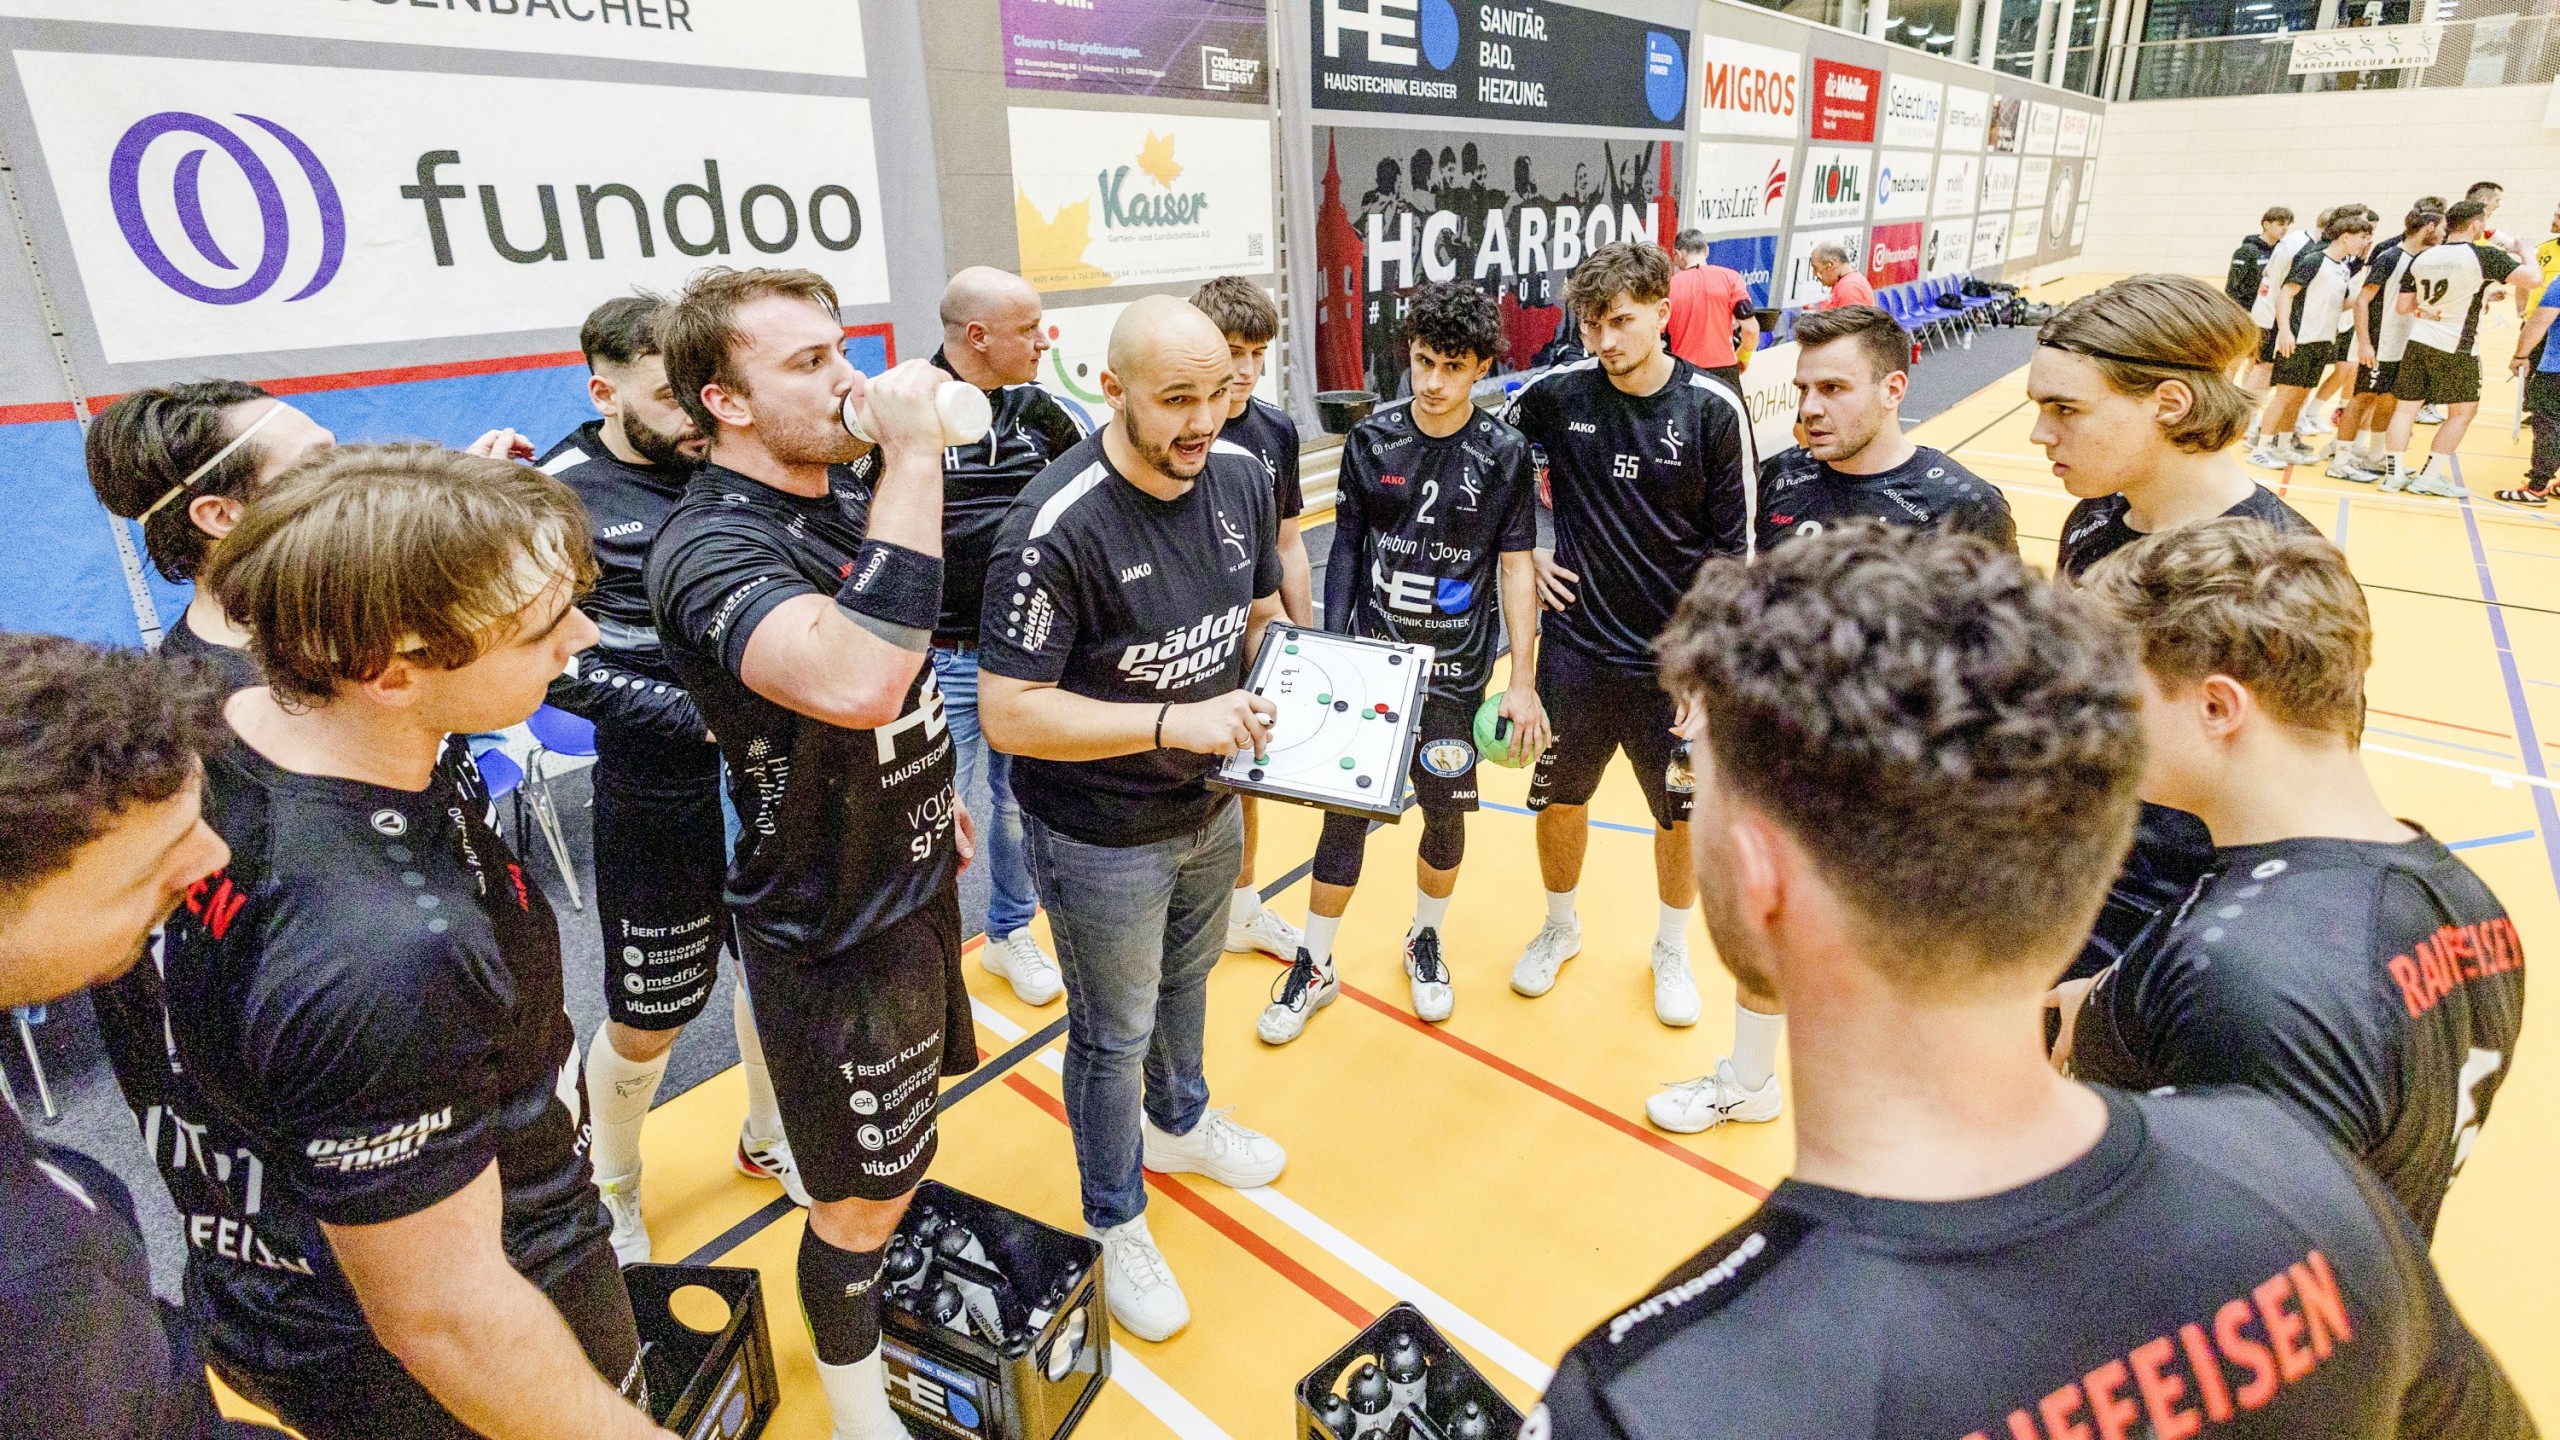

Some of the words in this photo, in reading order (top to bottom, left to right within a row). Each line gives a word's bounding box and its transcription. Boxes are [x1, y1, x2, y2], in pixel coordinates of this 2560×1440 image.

[1480, 4, 1548, 42] SANITÄR.
[1013, 34, 1056, 50] Clevere
[1057, 39, 1143, 59] Energielösungen.
[1480, 41, 1515, 71] BAD.
[1211, 55, 1260, 71] CONCEPT
[1211, 69, 1255, 85] ENERGY
[2295, 57, 2384, 69] HANDBALLCLUB
[2391, 56, 2430, 65] ARBON
[1324, 72, 1408, 96] HAUSTECHNIK
[1409, 79, 1457, 100] EUGSTER
[1479, 76, 1548, 107] HEIZUNG.
[1703, 61, 1796, 117] MIGROS
[400, 150, 862, 267] fundoo
[1098, 165, 1208, 229] Kaiser
[1108, 233, 1136, 243] Garten-
[1138, 232, 1152, 242] und
[1154, 231, 1199, 242] Landschaftsbau
[1201, 230, 1211, 239] AG
[1368, 208, 1458, 292] HC
[1473, 202, 1659, 280] ARBON
[2421, 278, 2449, 305] 19
[1568, 421, 1596, 434] JAKO
[1384, 436, 1413, 452] fundoo
[1461, 441, 1495, 467] SelectLine
[1380, 474, 1406, 486] JAKO
[1613, 453, 1640, 480] 55
[1416, 479, 1439, 525] 2
[1883, 487, 1930, 523] SelectLine
[603, 520, 644, 538] JAKO
[1377, 531, 1418, 555] kybun
[1428, 541, 1471, 564] Joya
[852, 547, 889, 592] Kempa
[1121, 562, 1152, 583] JAKO
[1118, 601, 1252, 671] päddy
[1124, 632, 1241, 690] sport
[1172, 661, 1225, 690] arbon
[1451, 790, 1477, 799] JAKO
[1681, 801, 1697, 809] JA
[631, 926, 667, 938] BERIT
[671, 914, 711, 936] KLINIK
[648, 935, 710, 959] ORTHOPÄDIE
[648, 944, 707, 965] ROSENBERG
[646, 967, 699, 987] medfit
[626, 984, 707, 1014] vitalwerk
[857, 1055, 898, 1077] BERIT
[900, 1029, 940, 1062] KLINIK
[882, 1055, 940, 1102] ORTHOPÄDIE
[884, 1068, 938, 1111] ROSENBERG
[886, 1095, 932, 1140] medfit
[861, 1119, 937, 1177] vitalwerk
[1960, 1248, 2352, 1440] FFEISEN
